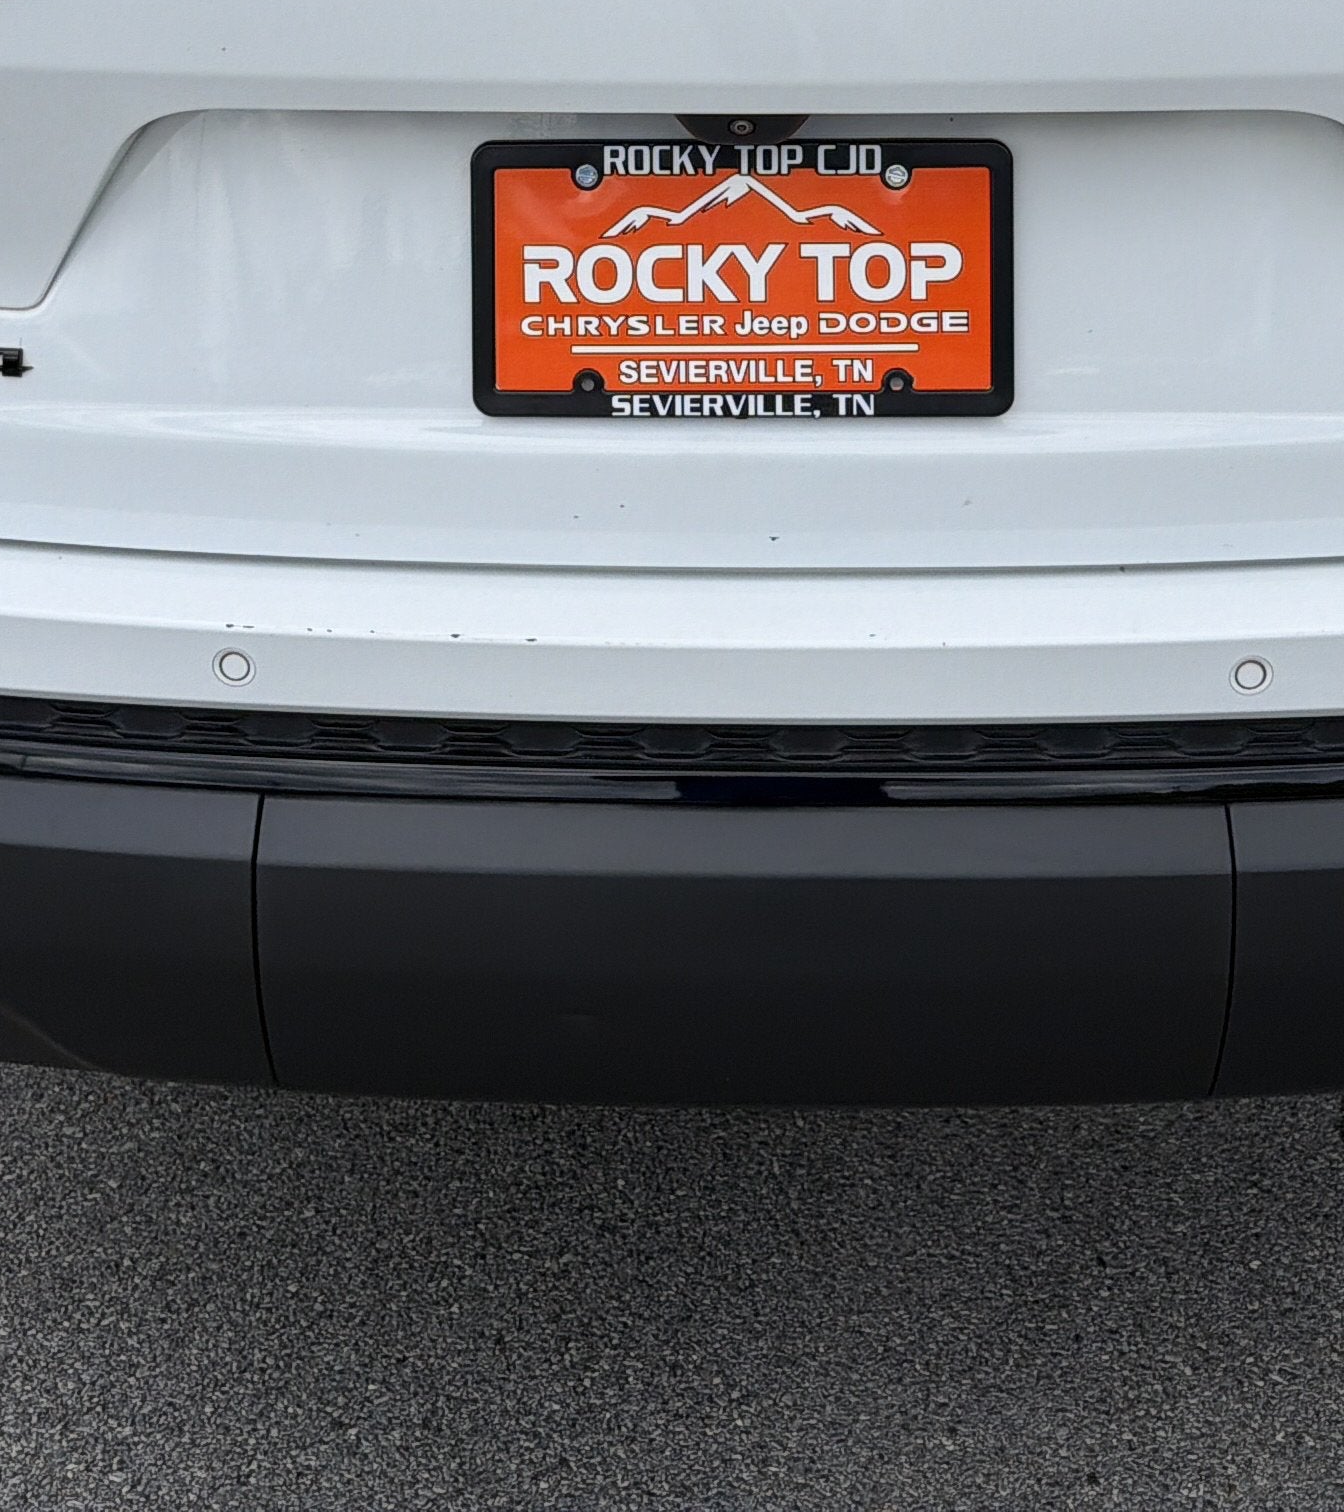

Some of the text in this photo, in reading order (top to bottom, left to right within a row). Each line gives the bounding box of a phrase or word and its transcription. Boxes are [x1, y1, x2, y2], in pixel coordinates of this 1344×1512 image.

[603, 143, 884, 176] ROCKY TOP CJD
[521, 241, 964, 304] ROCKY TOP
[520, 308, 970, 339] CHRYSLER Jeep DODGE
[618, 358, 873, 388] SEVIERVILLE, TN
[611, 394, 875, 419] SEVIERVILLE, TN
